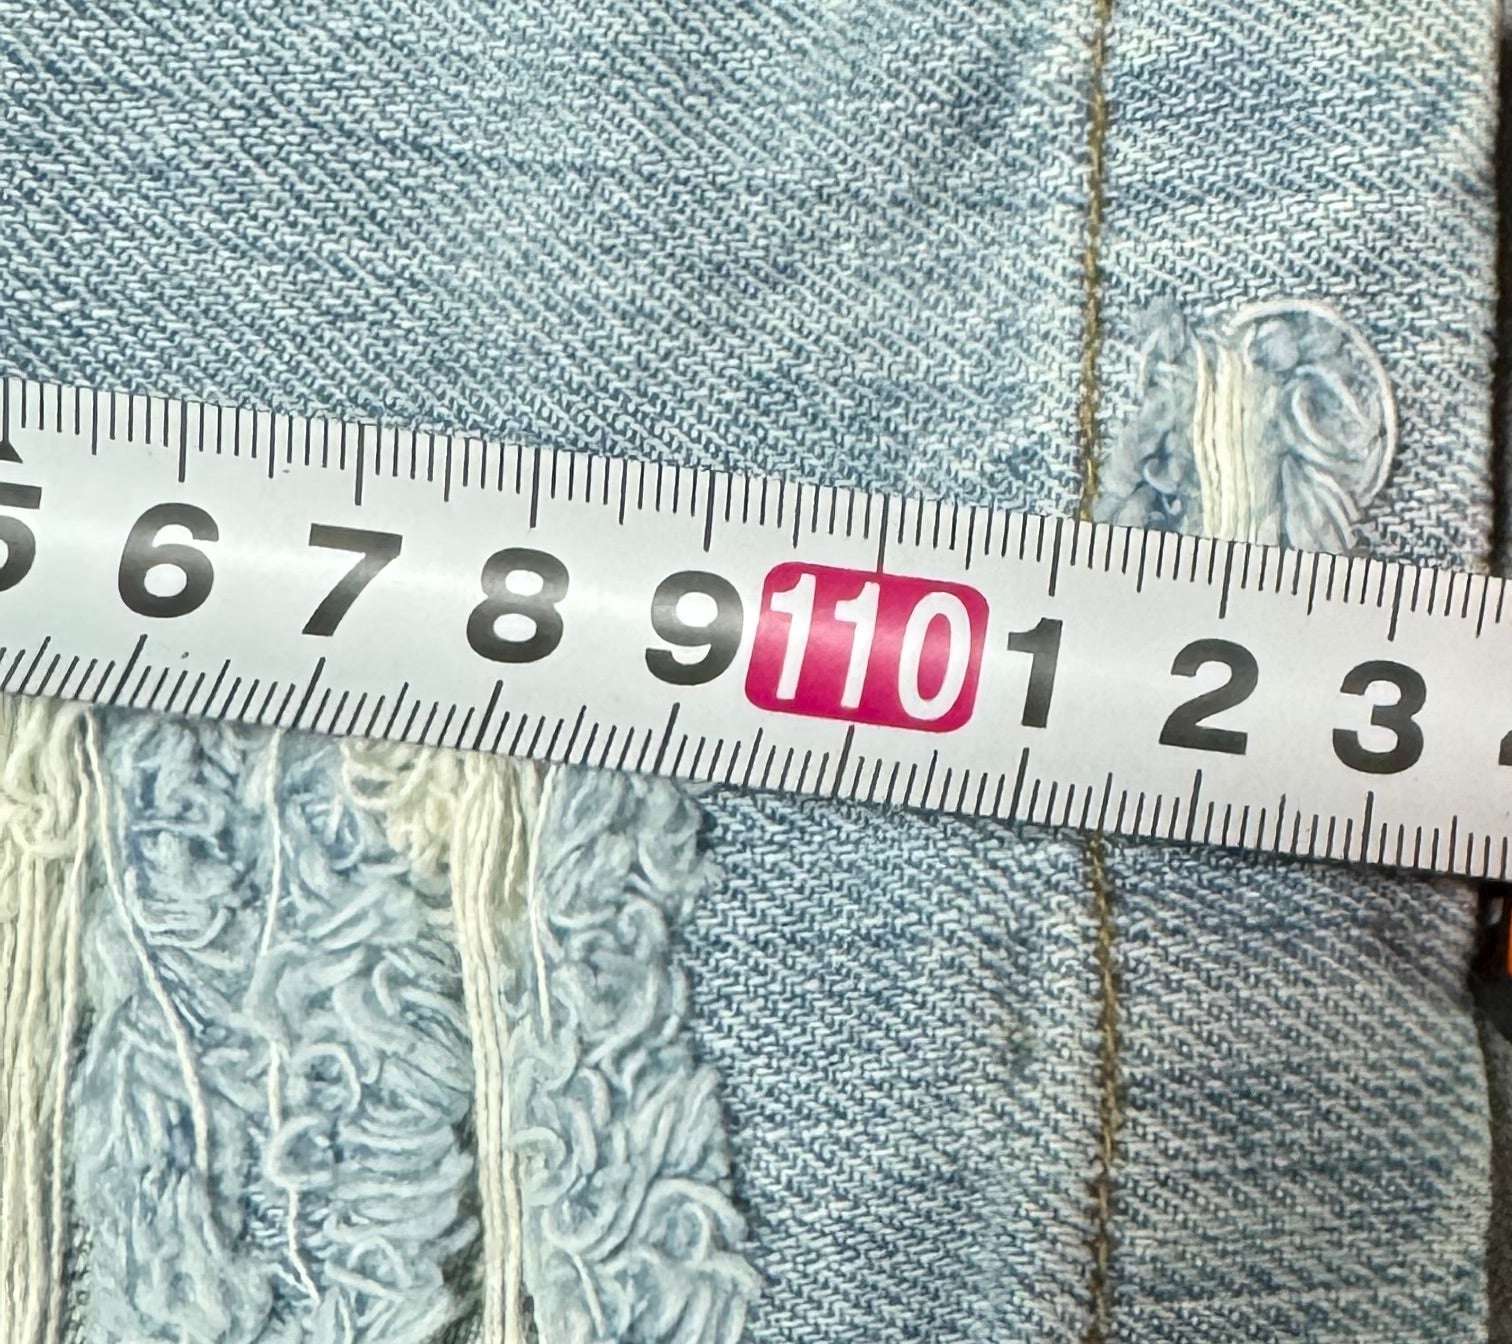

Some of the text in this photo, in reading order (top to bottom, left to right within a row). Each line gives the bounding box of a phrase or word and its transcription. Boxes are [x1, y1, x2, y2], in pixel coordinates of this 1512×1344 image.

[117, 502, 219, 618] 6
[302, 523, 403, 637] 7
[466, 547, 570, 664] 8
[644, 570, 744, 686] 9
[770, 572, 972, 721] 110
[1007, 617, 1064, 729] 1
[1158, 638, 1259, 755] 2
[1332, 660, 1427, 775] 3
